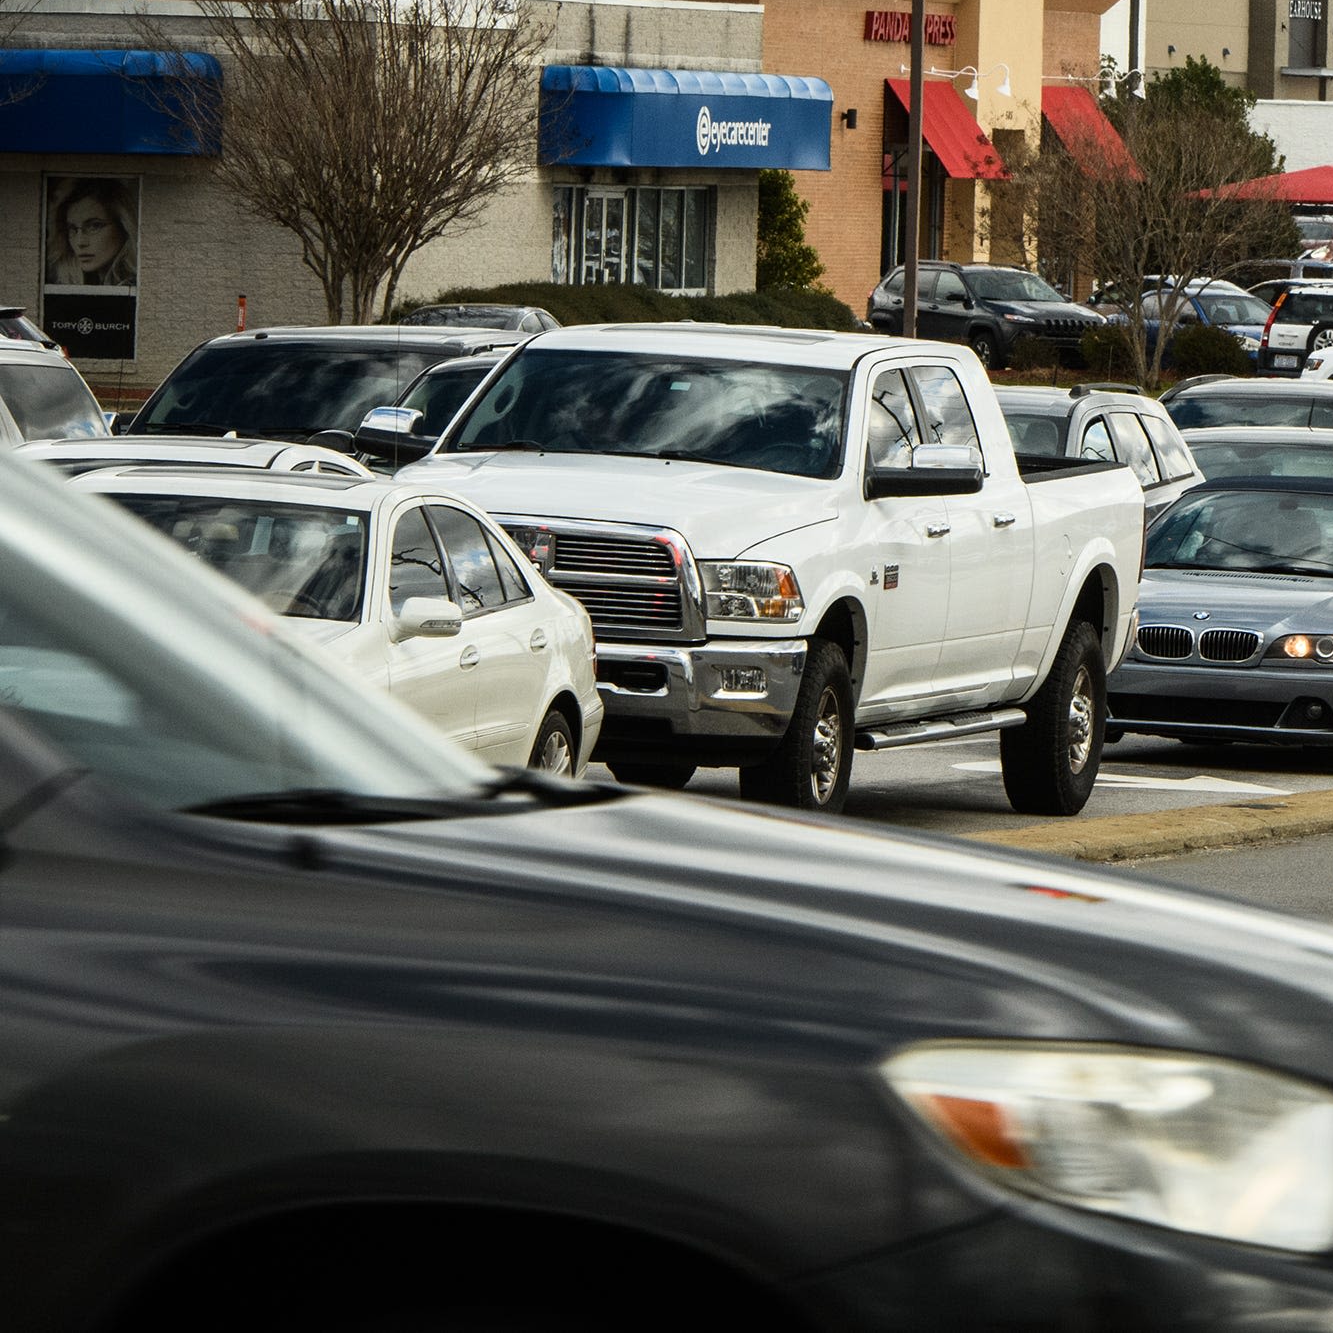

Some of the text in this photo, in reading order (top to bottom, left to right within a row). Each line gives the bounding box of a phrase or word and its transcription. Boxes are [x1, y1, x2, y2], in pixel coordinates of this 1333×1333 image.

[870, 11, 958, 46] PANDA PRESS
[52, 321, 130, 330] TORY BURCH
